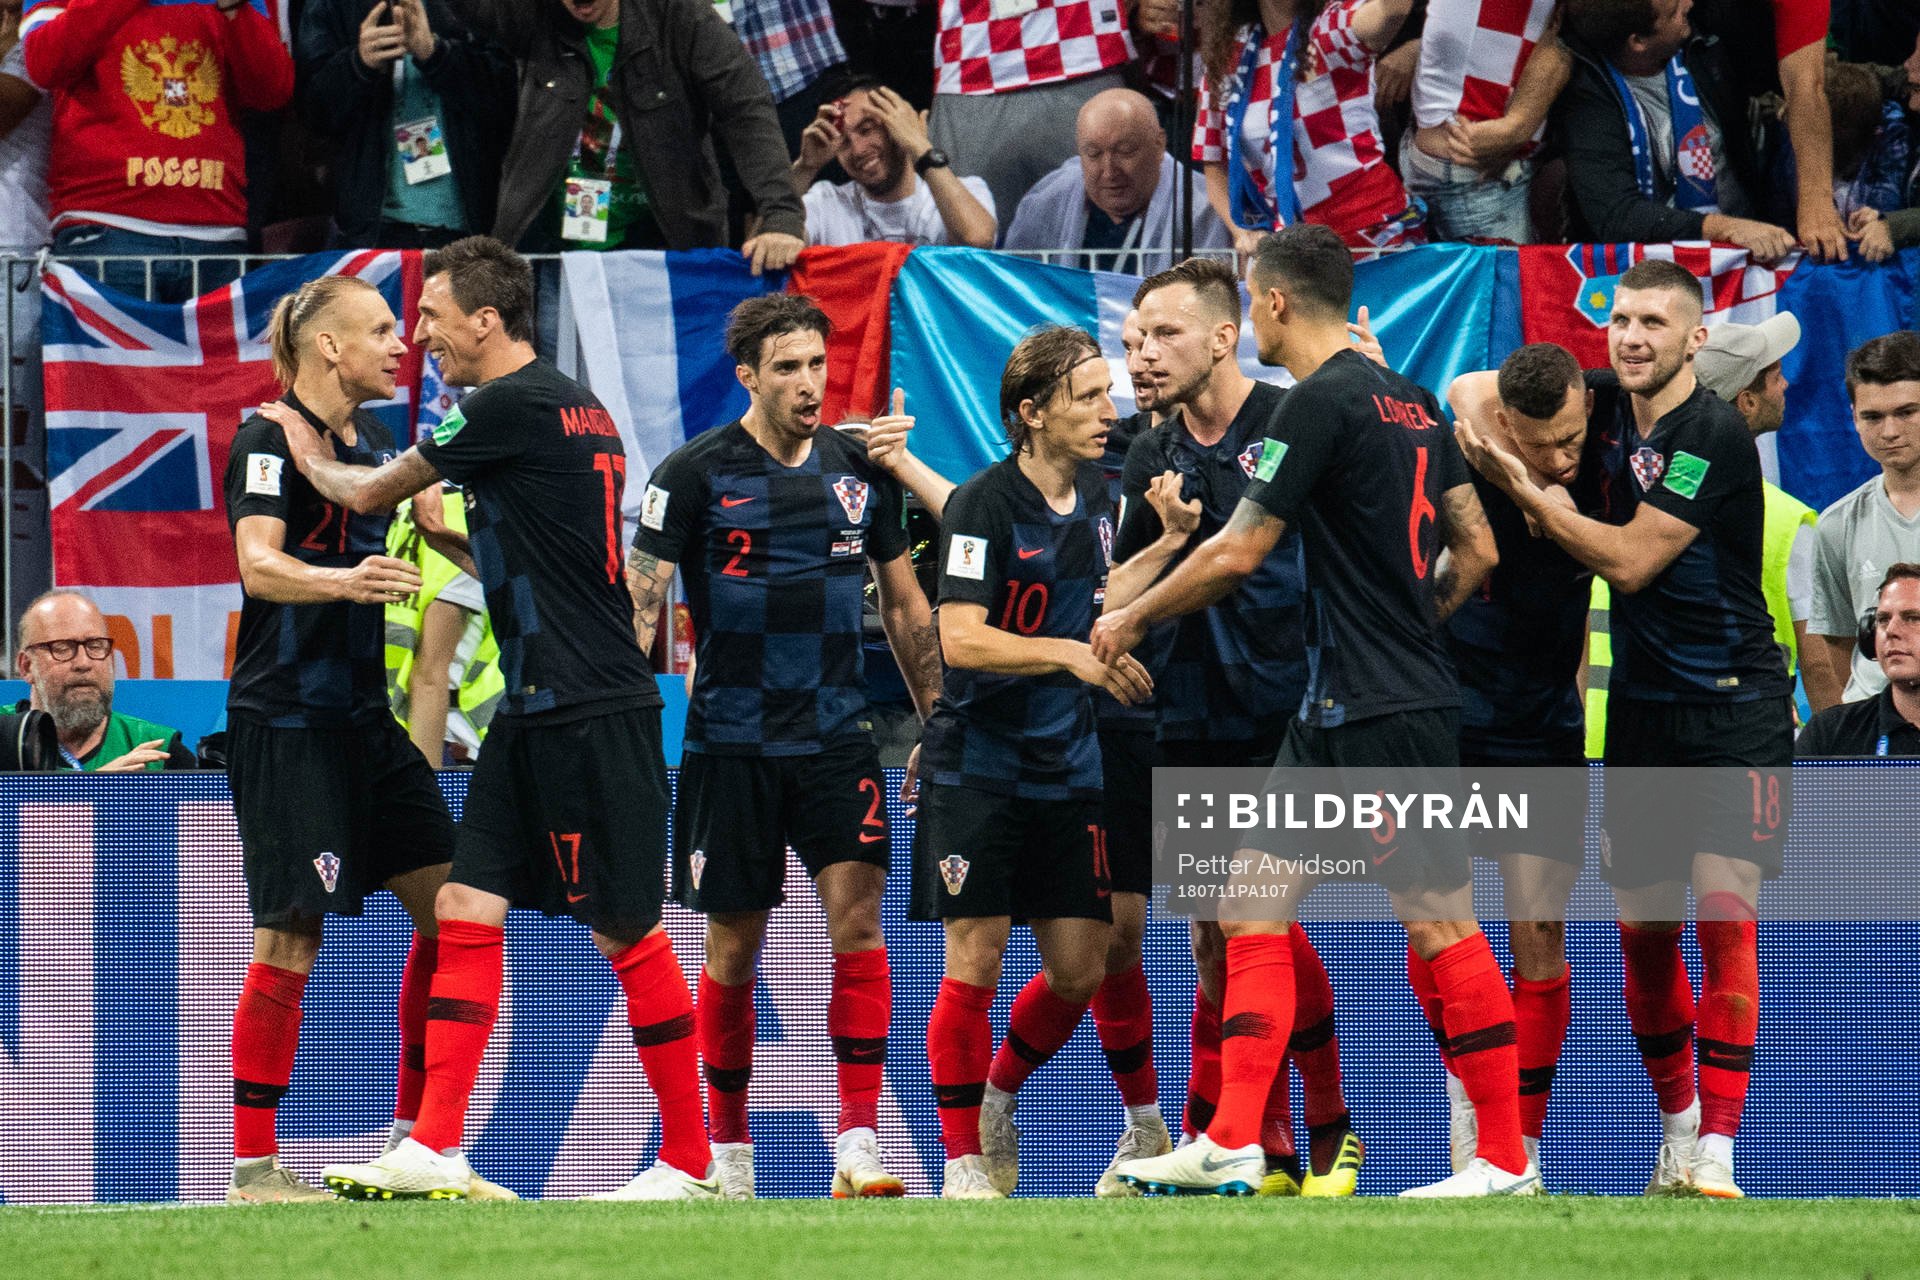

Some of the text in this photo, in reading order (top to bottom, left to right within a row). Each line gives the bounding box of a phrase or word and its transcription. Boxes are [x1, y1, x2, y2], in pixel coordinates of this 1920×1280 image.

[300, 503, 348, 554] 21
[1408, 447, 1436, 580] 6
[722, 529, 751, 577] 2
[1001, 579, 1048, 634] 10
[858, 777, 884, 828] 2
[1747, 769, 1781, 829] 18
[549, 831, 582, 884] 17
